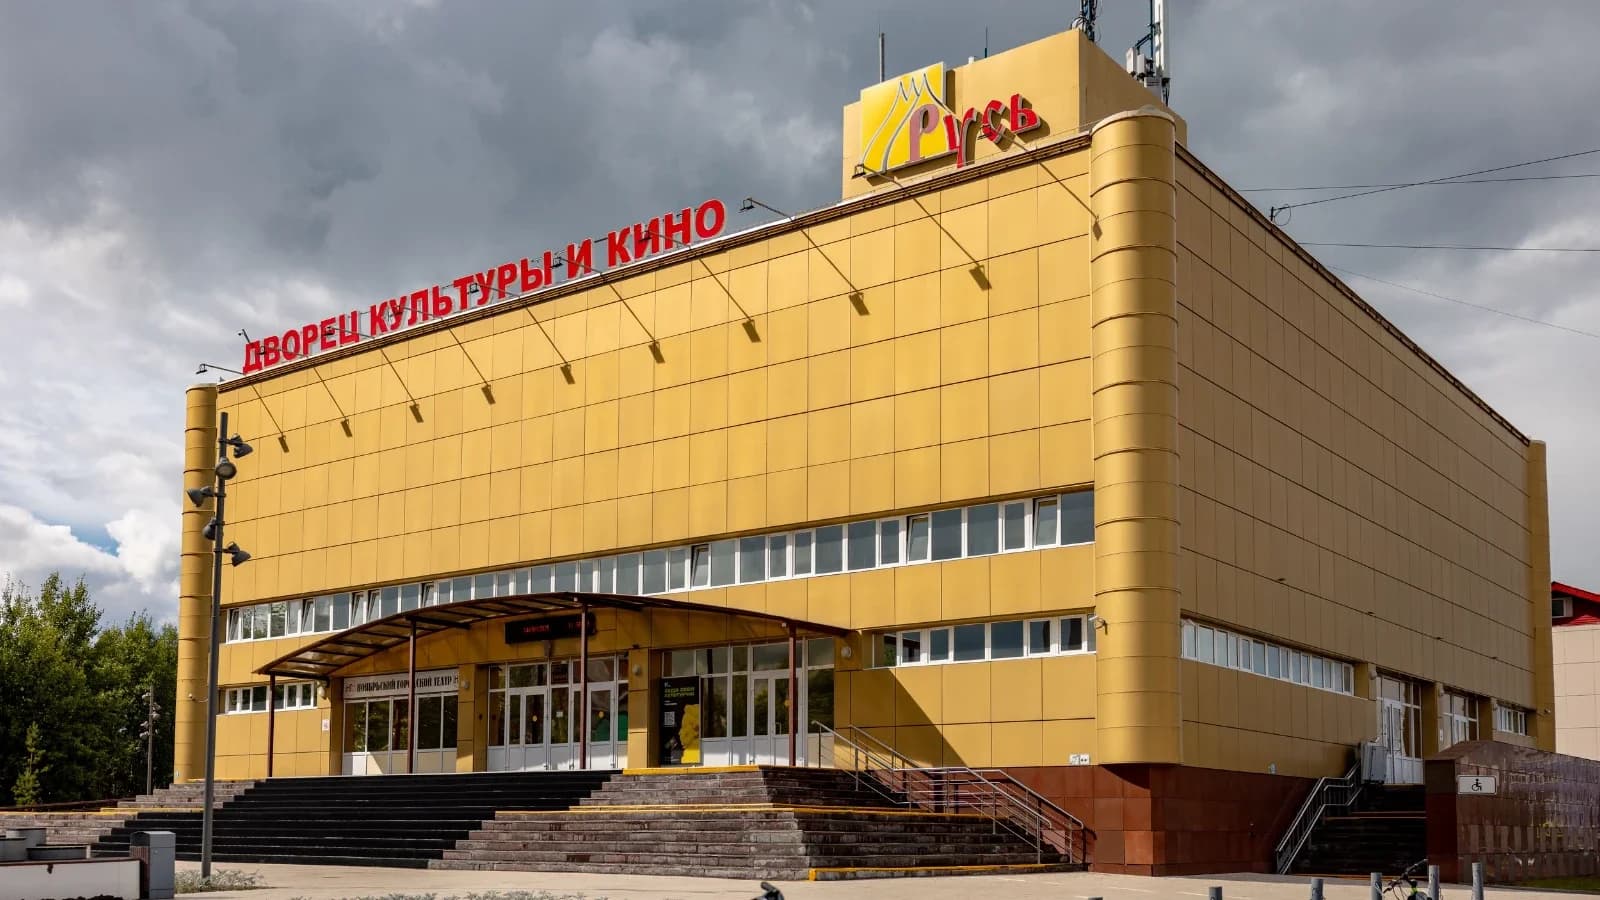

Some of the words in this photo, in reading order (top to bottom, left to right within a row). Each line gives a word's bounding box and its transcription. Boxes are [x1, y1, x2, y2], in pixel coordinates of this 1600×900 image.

[241, 310, 359, 375] ДВОРЕЦ
[369, 250, 552, 334] КУЛЬТУРЫ
[567, 237, 592, 280] И
[607, 198, 727, 268] КИНО
[396, 675, 432, 690] ГОРСКОЙ
[434, 676, 452, 687] ТЕАТР
